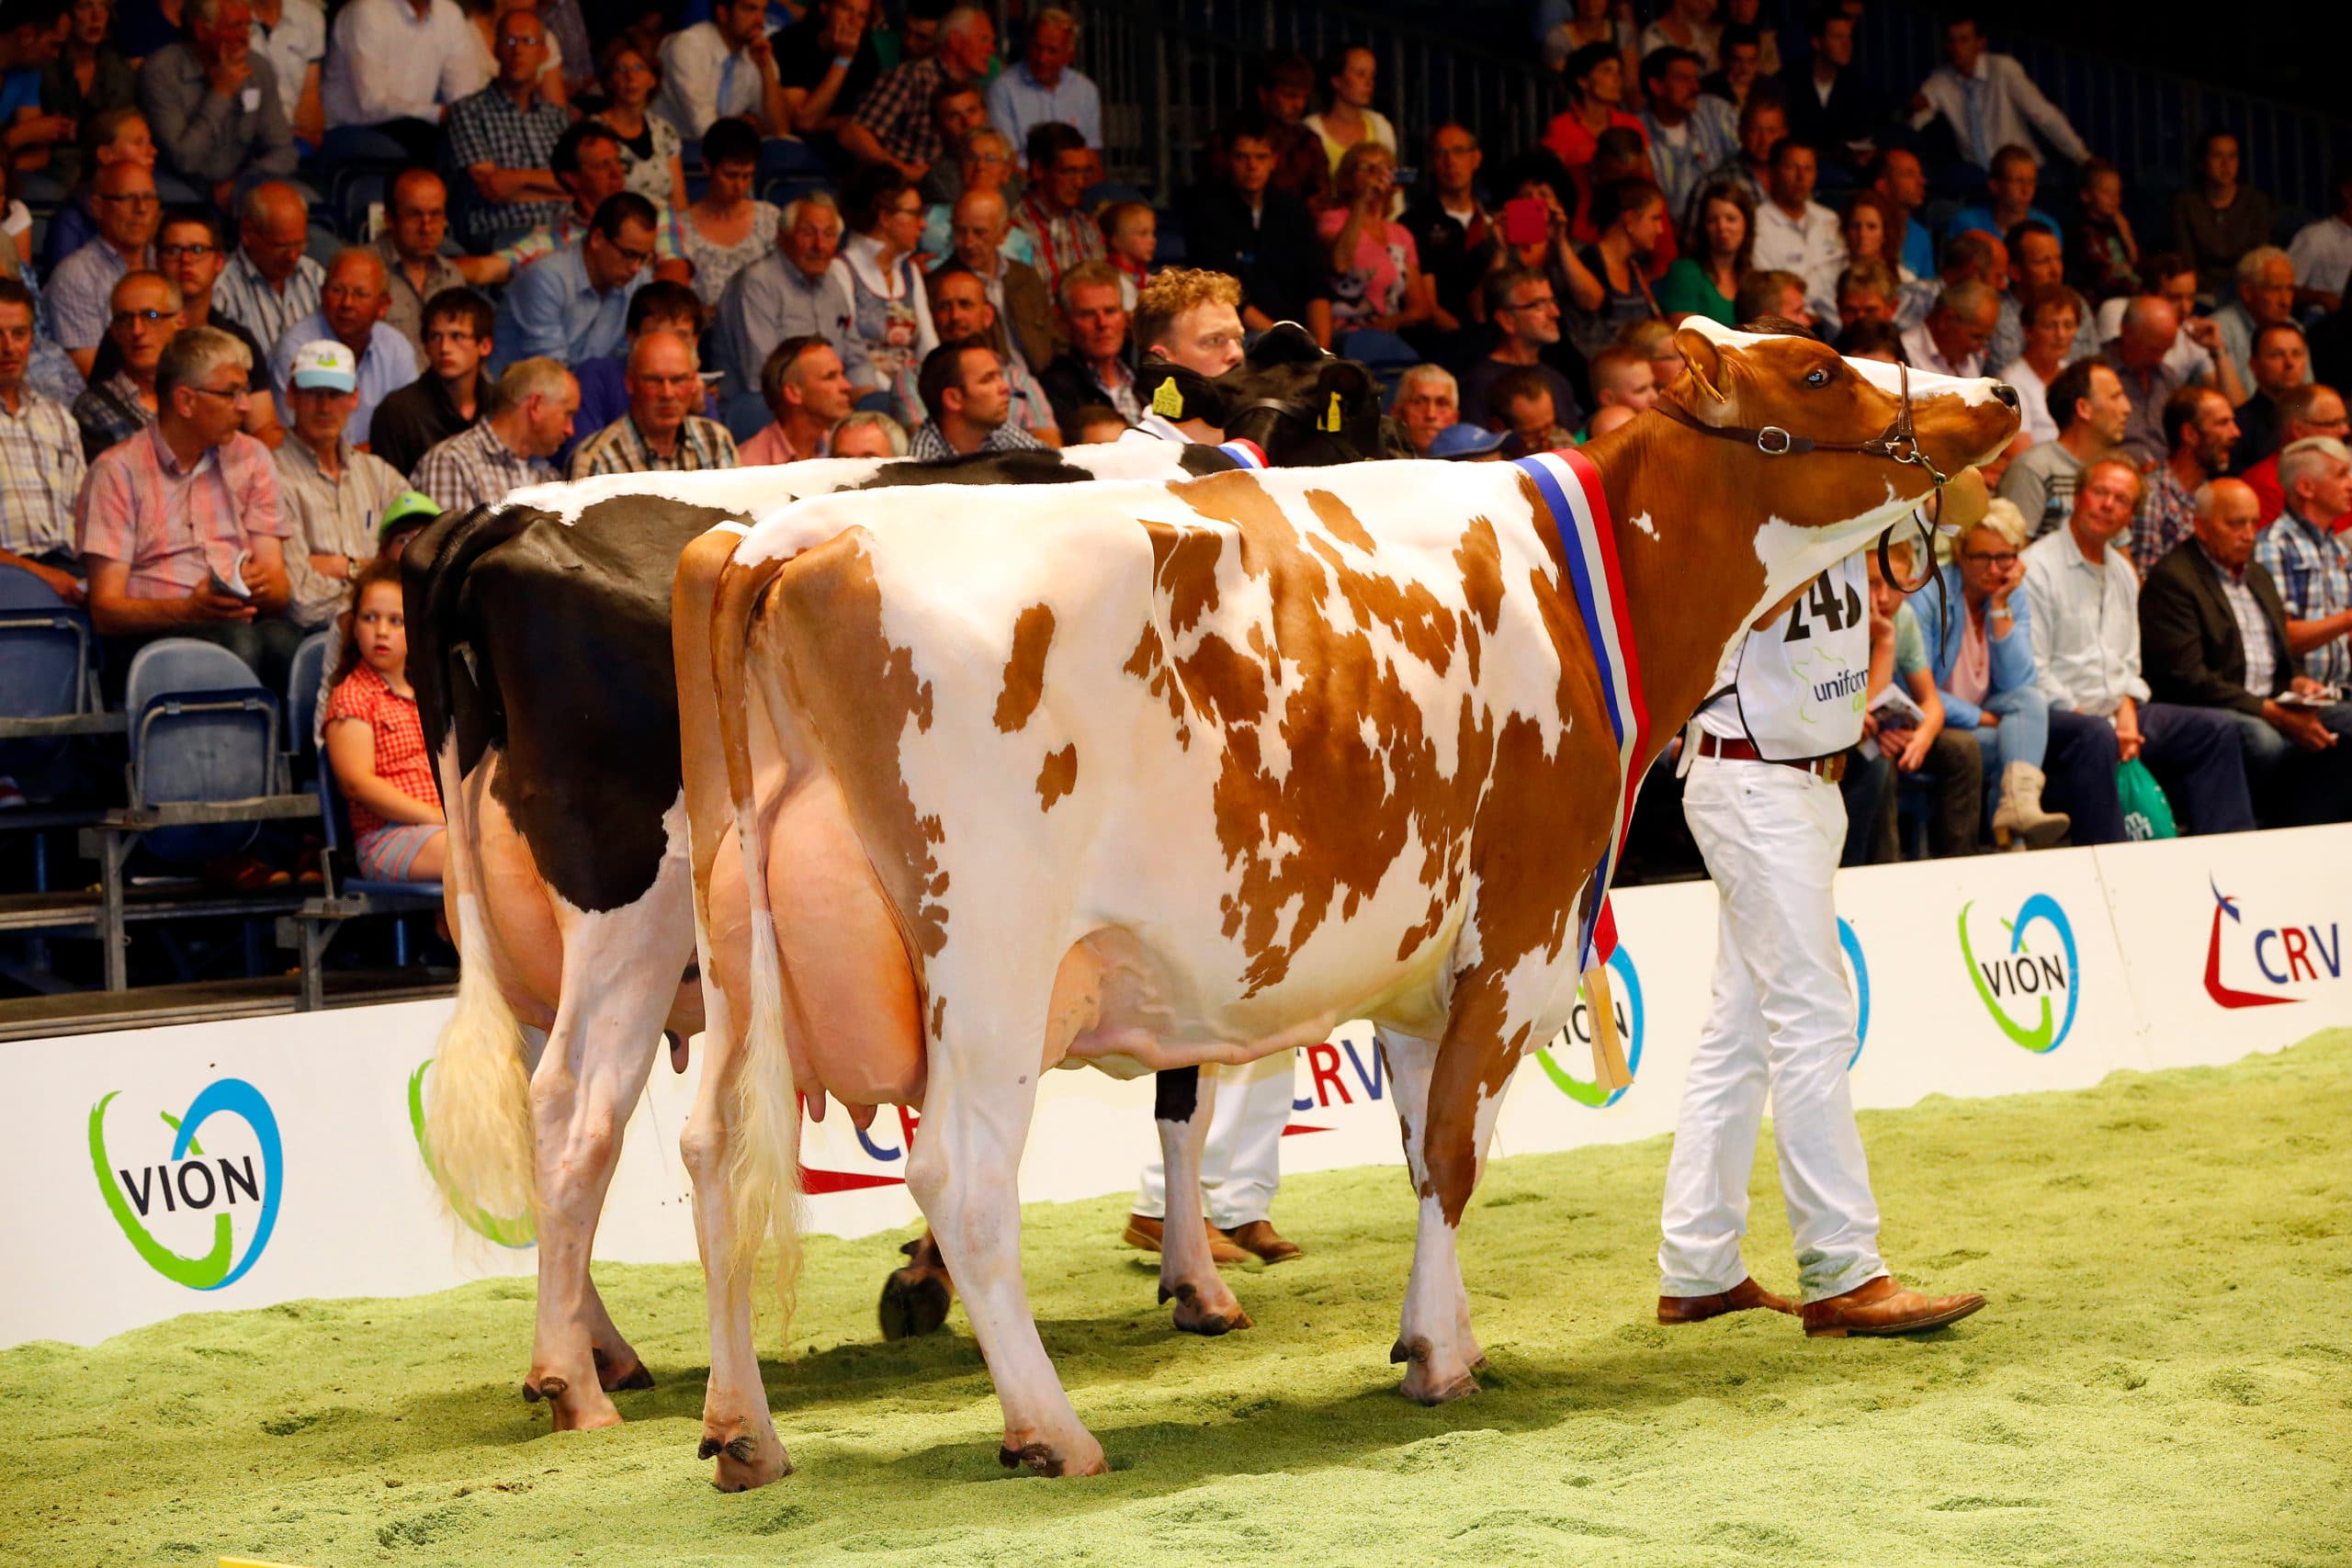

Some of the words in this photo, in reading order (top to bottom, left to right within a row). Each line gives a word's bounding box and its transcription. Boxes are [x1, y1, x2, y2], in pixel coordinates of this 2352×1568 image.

[1981, 953, 2065, 997] VION
[2255, 923, 2340, 985] CRV
[1292, 1036, 1382, 1111] RV
[119, 1156, 259, 1216] VION
